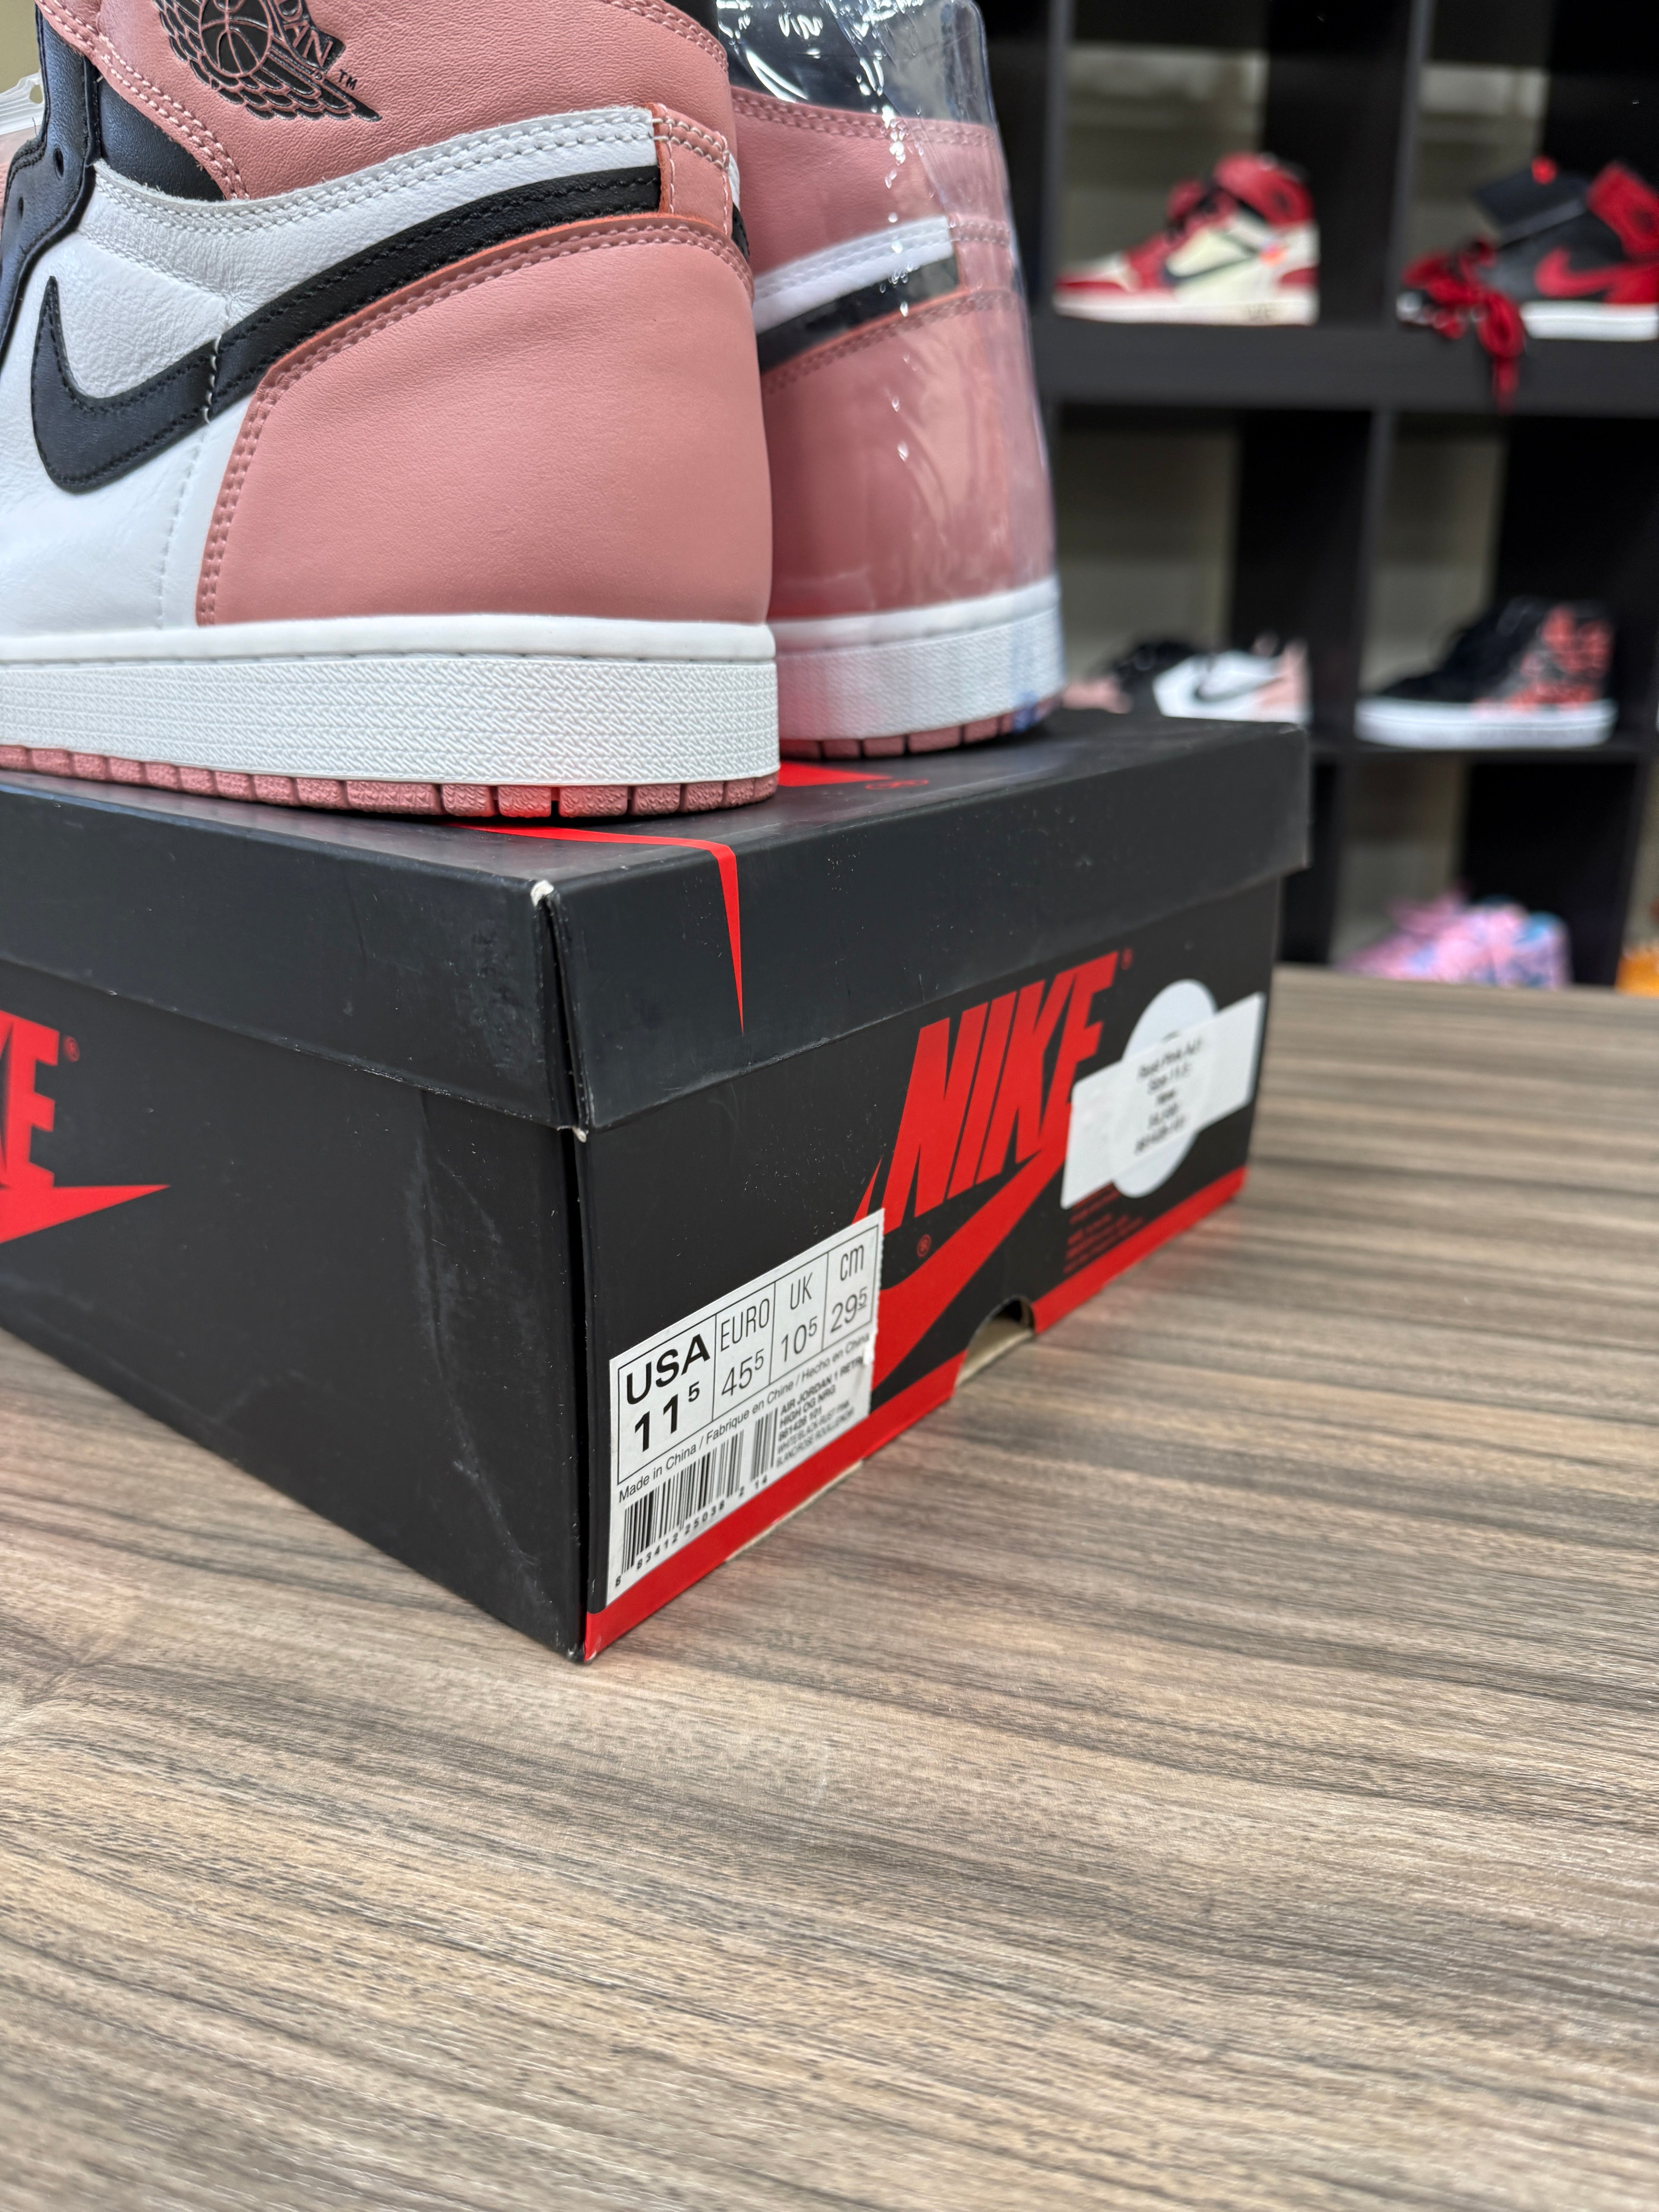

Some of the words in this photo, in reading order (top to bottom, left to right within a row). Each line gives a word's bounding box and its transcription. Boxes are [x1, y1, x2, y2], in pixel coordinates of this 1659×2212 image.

[339, 69, 358, 90] TM
[881, 951, 1118, 1235] NIKE
[790, 1271, 813, 1310] UK
[840, 1244, 864, 1281] cm
[720, 1298, 770, 1352] EURO
[626, 1333, 711, 1405] USA
[780, 1398, 796, 1417] AIR
[797, 1375, 832, 1405] JORDAN
[839, 1356, 864, 1376] RETR
[619, 1475, 649, 1503] Made
[653, 1466, 662, 1479] in
[666, 1443, 696, 1470] China
[706, 1409, 749, 1445] Fabrique
[752, 1400, 764, 1414] en
[767, 1381, 794, 1404] Chine
[801, 1358, 830, 1383] Hecho
[832, 1349, 843, 1362] en
[779, 1407, 801, 1429] HIGH
[803, 1397, 816, 1413] OG
[817, 1384, 836, 1403] NRG
[615, 1575, 622, 1587] 8
[739, 1486, 745, 1497] 2
